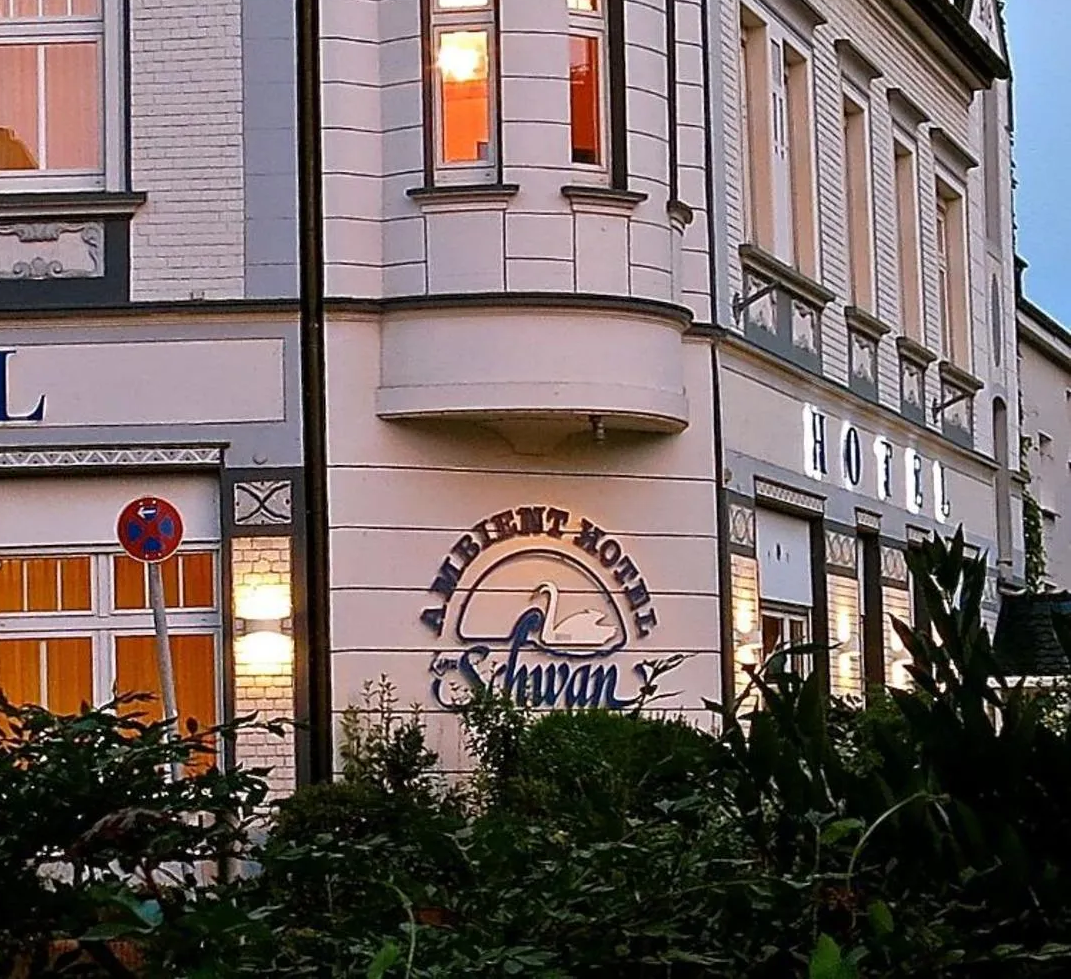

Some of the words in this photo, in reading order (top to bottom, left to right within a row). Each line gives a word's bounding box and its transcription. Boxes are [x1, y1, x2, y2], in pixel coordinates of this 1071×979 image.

[805, 405, 951, 521] HOTEL
[420, 506, 571, 637] AMBIENT
[574, 518, 659, 639] HOTEL
[432, 623, 647, 709] Schwan
